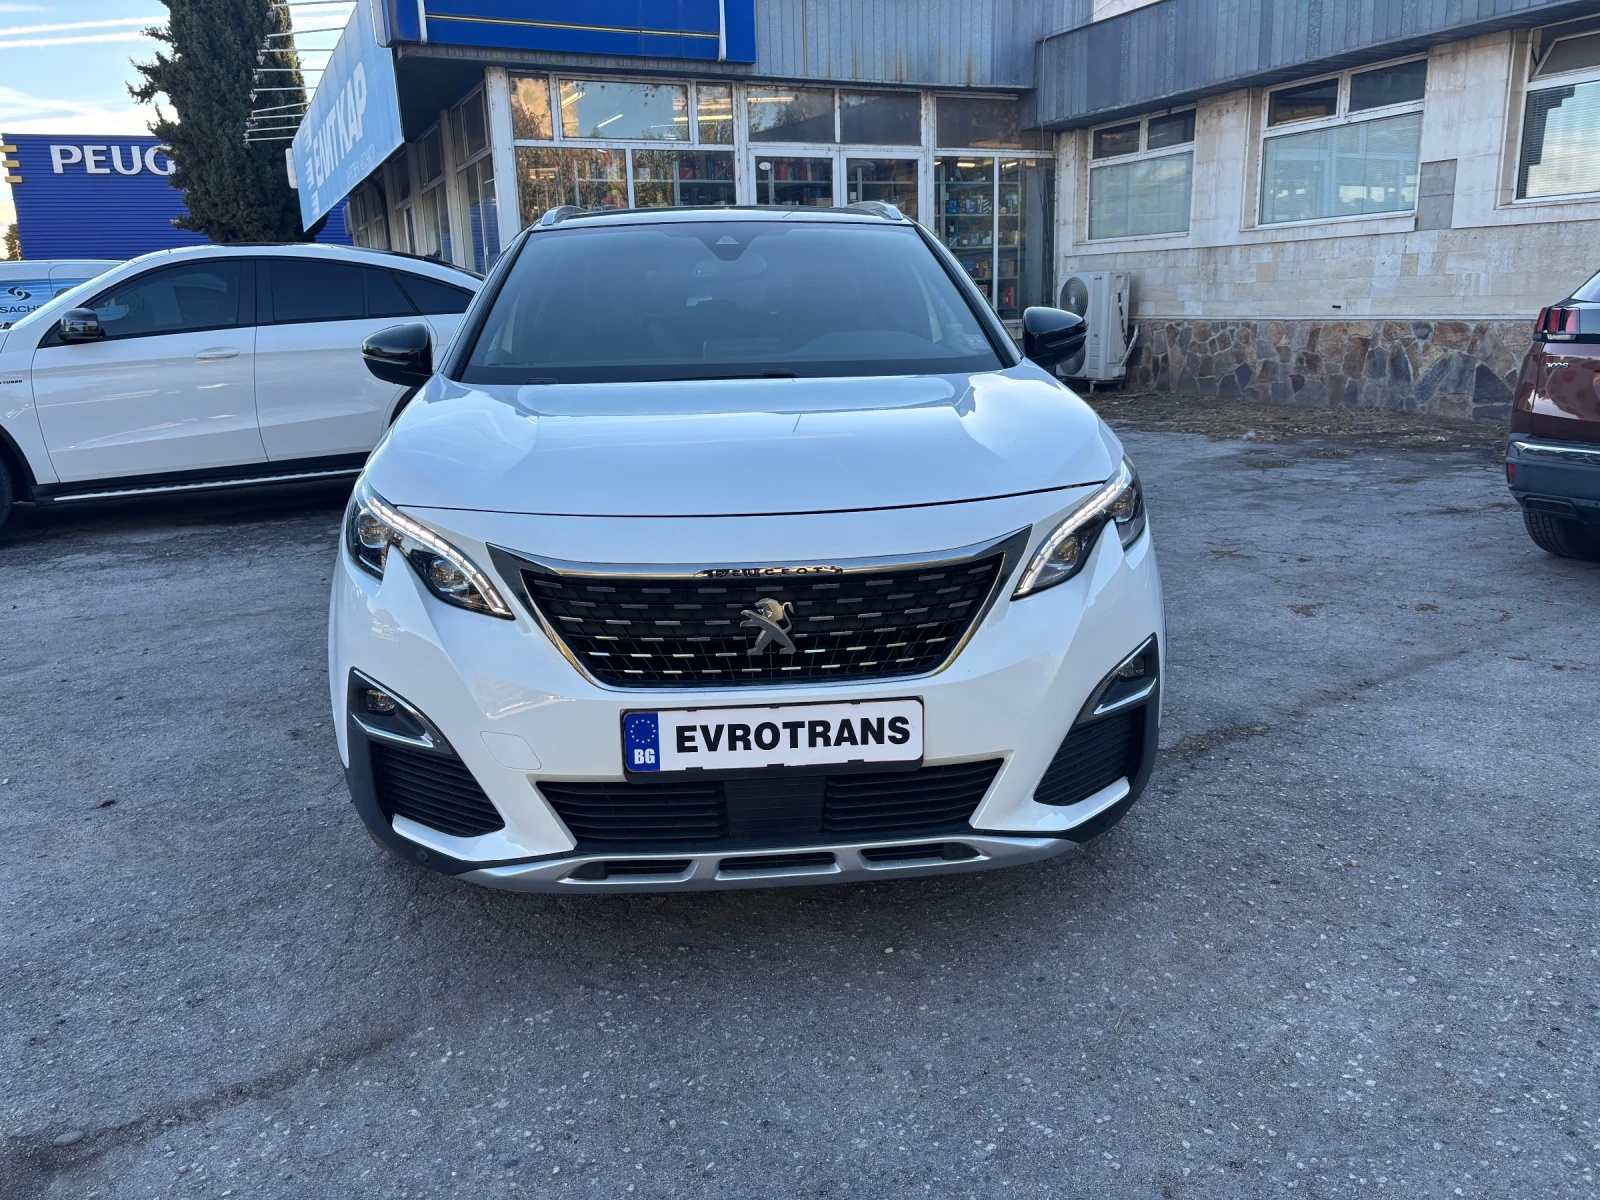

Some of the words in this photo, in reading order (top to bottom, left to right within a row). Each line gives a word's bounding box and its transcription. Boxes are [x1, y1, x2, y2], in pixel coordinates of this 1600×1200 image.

[50, 145, 177, 176] PEUG
[715, 566, 823, 579] PEUGEOT
[676, 716, 911, 753] EVROTRANS
[634, 749, 656, 765] BG
